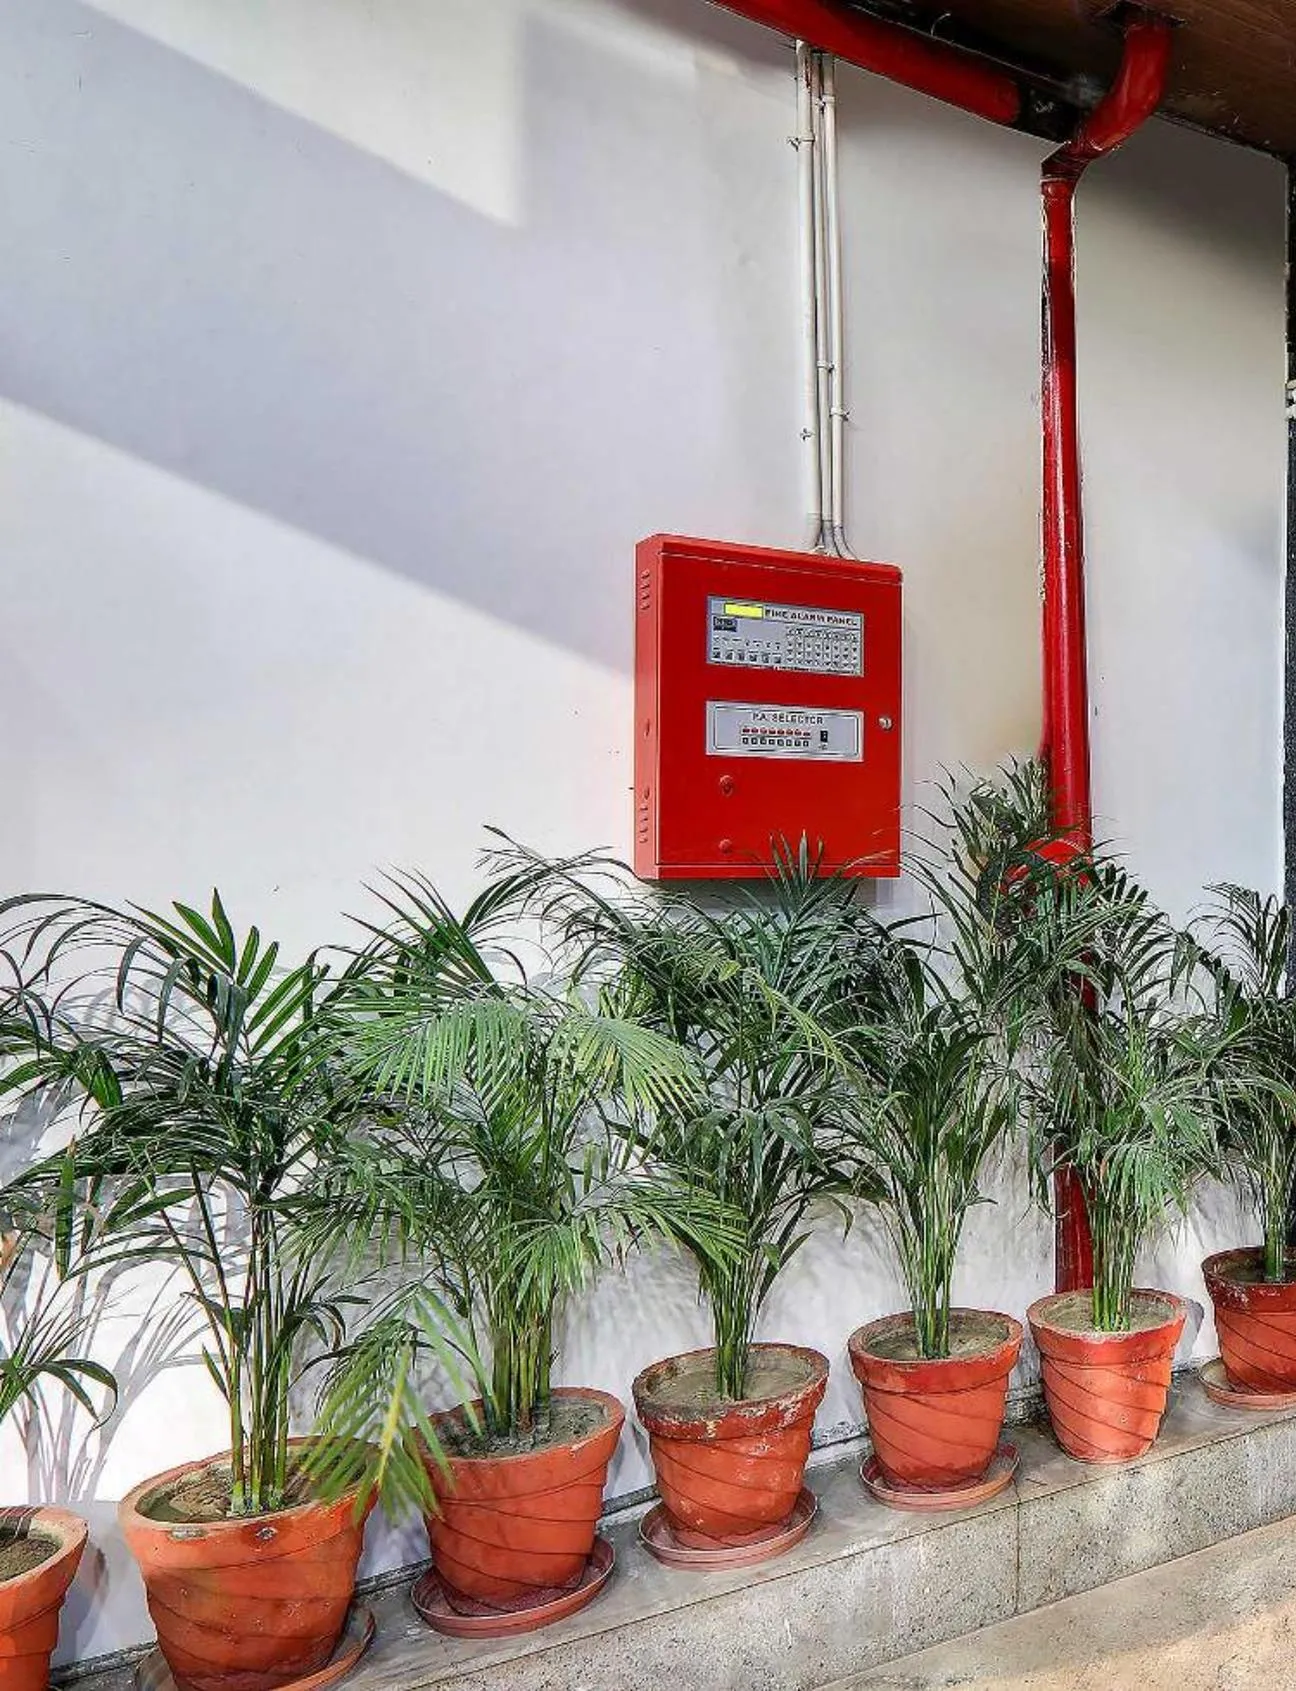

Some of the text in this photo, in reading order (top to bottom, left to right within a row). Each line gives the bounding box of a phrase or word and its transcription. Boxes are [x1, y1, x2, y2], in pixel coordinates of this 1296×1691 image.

[765, 608, 858, 626] FIRE ALARM PANEL
[772, 713, 824, 724] SELECTOR
